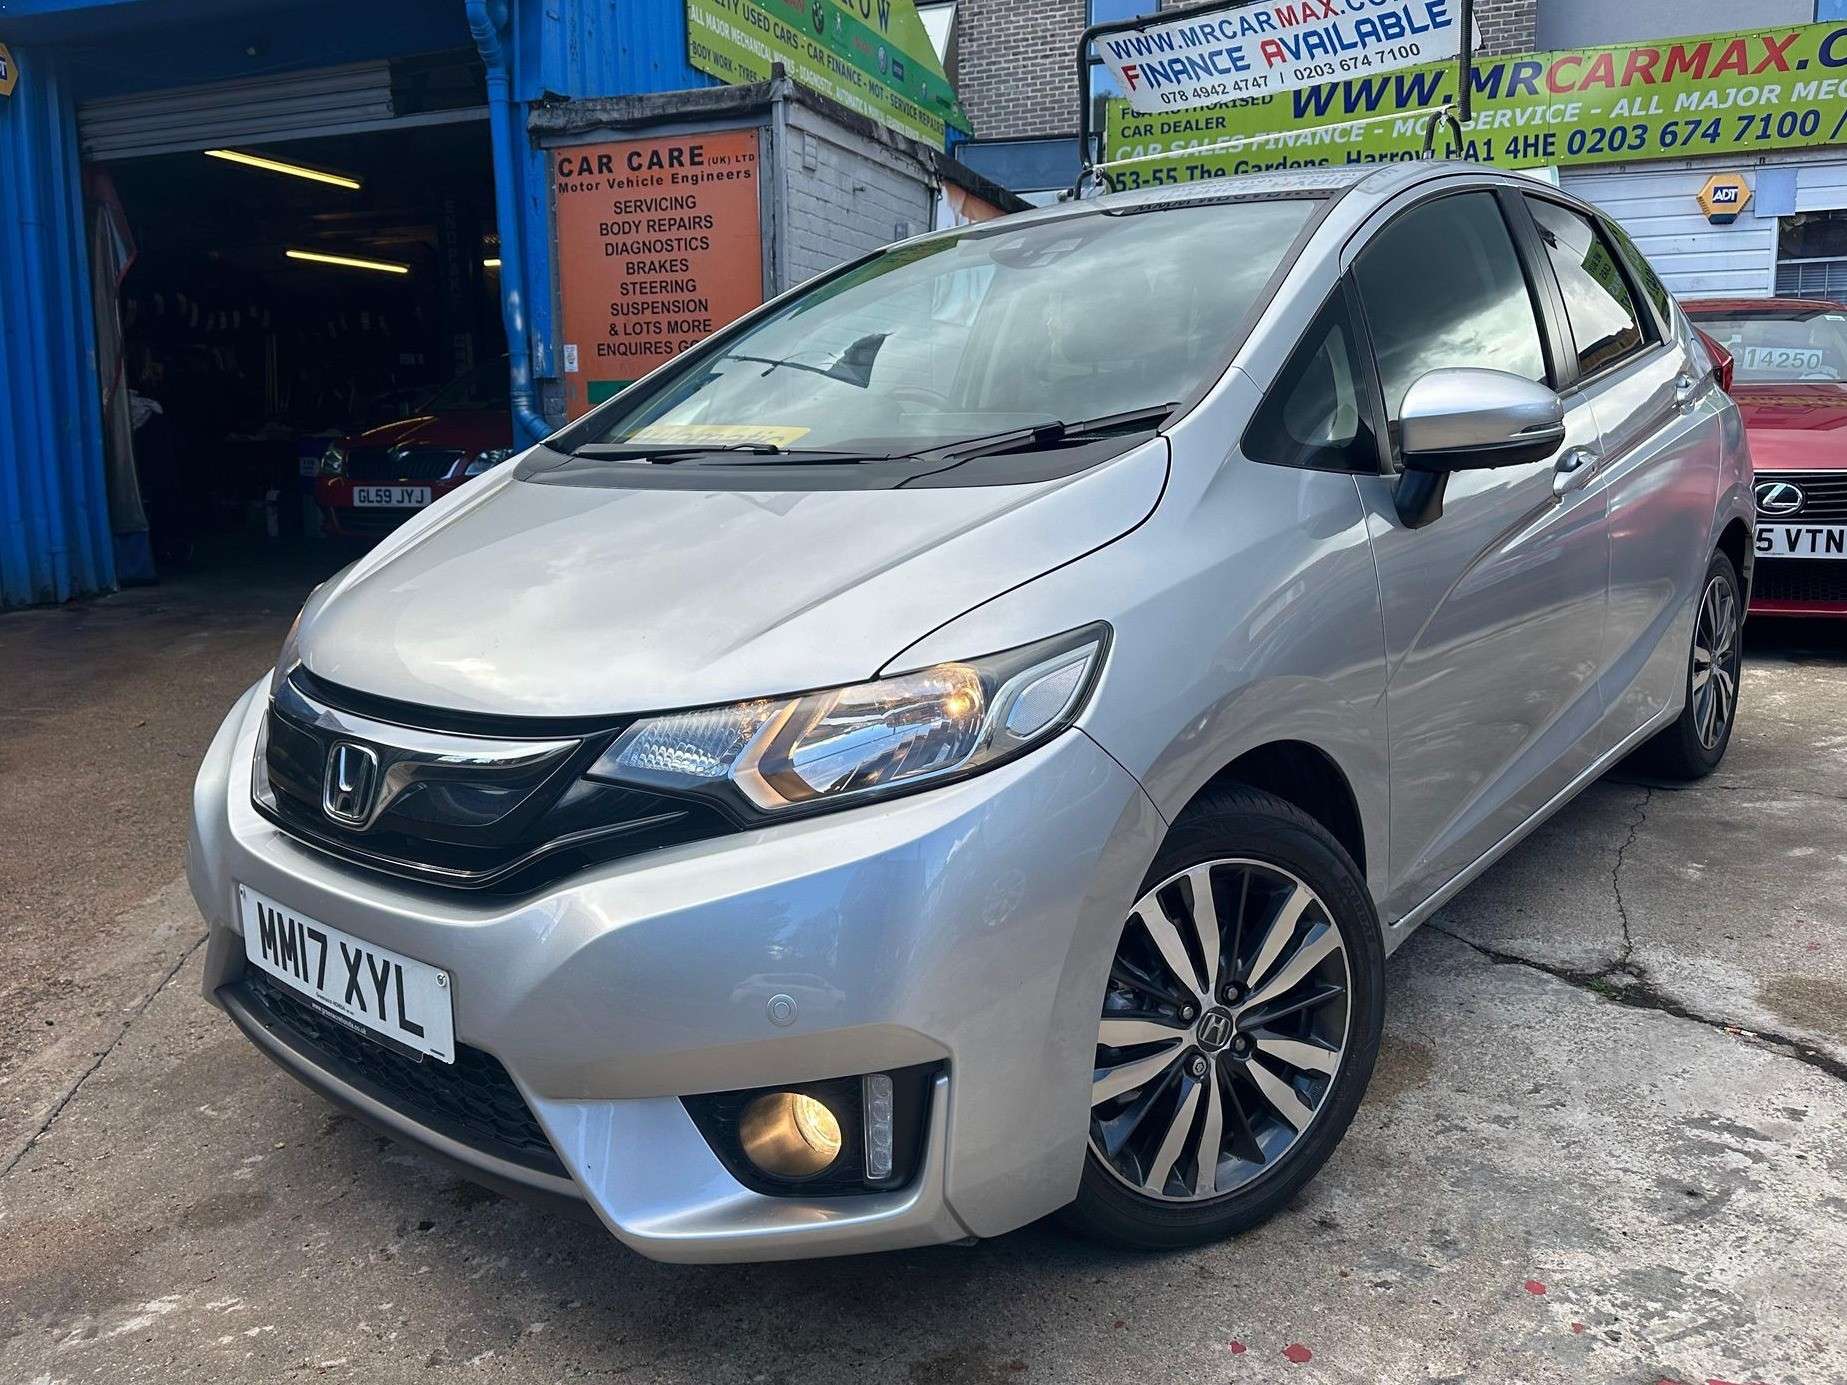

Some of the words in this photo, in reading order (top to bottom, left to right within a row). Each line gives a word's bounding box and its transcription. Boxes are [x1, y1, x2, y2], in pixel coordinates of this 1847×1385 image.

[689, 3, 705, 27] ALL
[706, 11, 730, 40] MAJOR
[1106, 0, 1400, 60] WWW.MRCARMAX.C
[692, 41, 711, 62] BODY
[713, 51, 733, 72] WORK
[1120, 46, 1251, 91] FINANCE
[1260, 0, 1452, 69] AVAILABLE
[742, 1, 770, 33] USED
[773, 23, 799, 49] CARS
[807, 43, 825, 67] CAR
[827, 55, 862, 88] FINANCE
[868, 79, 884, 98] MOT
[890, 92, 918, 121] SERVICE
[1160, 90, 1189, 105] 078
[1192, 82, 1230, 99] 4942
[1233, 75, 1268, 92] 4747
[1294, 62, 1335, 81] 0203
[1339, 54, 1373, 72] 674
[1375, 43, 1421, 64] 7100
[1115, 143, 1163, 161] CAR
[1167, 134, 1245, 158] SALES
[1251, 121, 1367, 151] FINANCE
[1460, 102, 1583, 132] SERVICE
[1608, 95, 1664, 118] ALL
[1673, 84, 1781, 113] MAJOR
[1121, 124, 1154, 139] CAR
[1160, 116, 1227, 134] DEALER
[558, 153, 614, 178] CAR
[626, 145, 704, 172] CARE
[707, 155, 731, 167] (UK)
[735, 153, 755, 163] LTD
[1116, 167, 1178, 192] 53-55
[1186, 163, 1226, 181] The
[1445, 138, 1495, 162] HA1
[1505, 132, 1557, 159] 4HE
[1566, 122, 1649, 155] 0203
[1659, 117, 1722, 148] 674
[1733, 109, 1821, 142] 7100
[558, 181, 601, 193] Motor
[607, 175, 664, 190] Vehicle
[671, 170, 752, 186] Engineers
[613, 194, 697, 215] SERVICING
[1712, 187, 1739, 202] ADT
[600, 219, 642, 236] BODY
[646, 214, 714, 233] REPAIRS
[604, 236, 710, 257] DIAGNOSTICS
[625, 258, 689, 276] BRAKES
[620, 278, 697, 297] STEERING
[610, 298, 709, 317] SUSPENSION
[608, 323, 619, 337] &
[623, 320, 662, 337] LOTS
[667, 318, 713, 335] MORE
[597, 340, 673, 357] ENQUIRES
[1747, 348, 1821, 369] 14250
[358, 488, 392, 505] GL59
[396, 488, 425, 504] JYJ
[1785, 528, 1845, 554] VTN
[256, 900, 328, 992] MM17
[339, 940, 425, 1039] XYL
